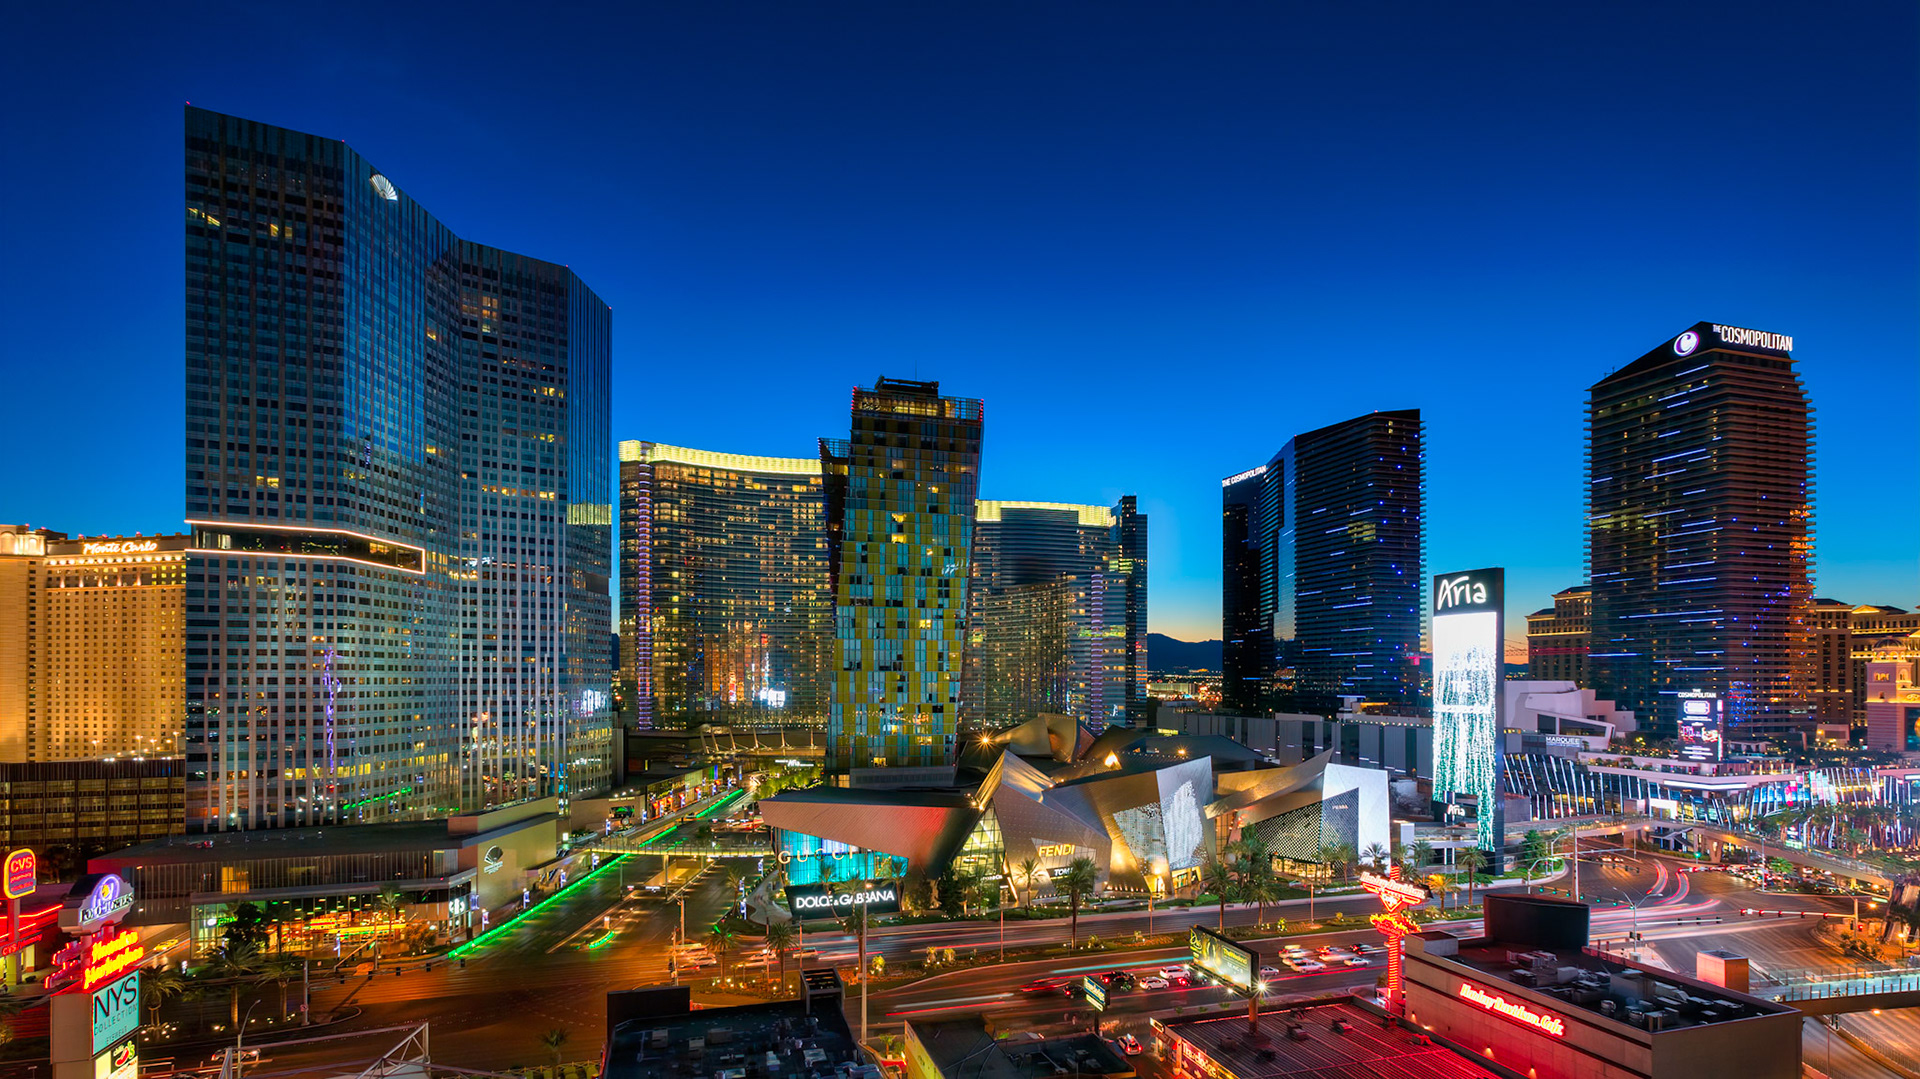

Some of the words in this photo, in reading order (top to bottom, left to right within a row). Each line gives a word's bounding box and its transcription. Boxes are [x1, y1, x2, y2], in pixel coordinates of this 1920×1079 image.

[1713, 324, 1721, 333] THE
[1721, 325, 1793, 352] COSMOPOLITAN
[1222, 478, 1231, 488] THE
[1231, 464, 1267, 484] COSMOPOLITAN
[83, 543, 120, 555] Monte
[121, 541, 157, 554] Carlo
[1437, 575, 1487, 611] Aria
[1545, 736, 1580, 744] MARQUEE
[1447, 804, 1465, 817] Aria
[778, 845, 853, 865] GUCCI
[1038, 843, 1076, 858] FENDI
[10, 856, 33, 873] CVS
[796, 895, 834, 909] DOLCE
[95, 976, 137, 1024] NYS
[95, 1003, 137, 1036] COLLECTION
[1182, 1042, 1217, 1078] Travelodge
